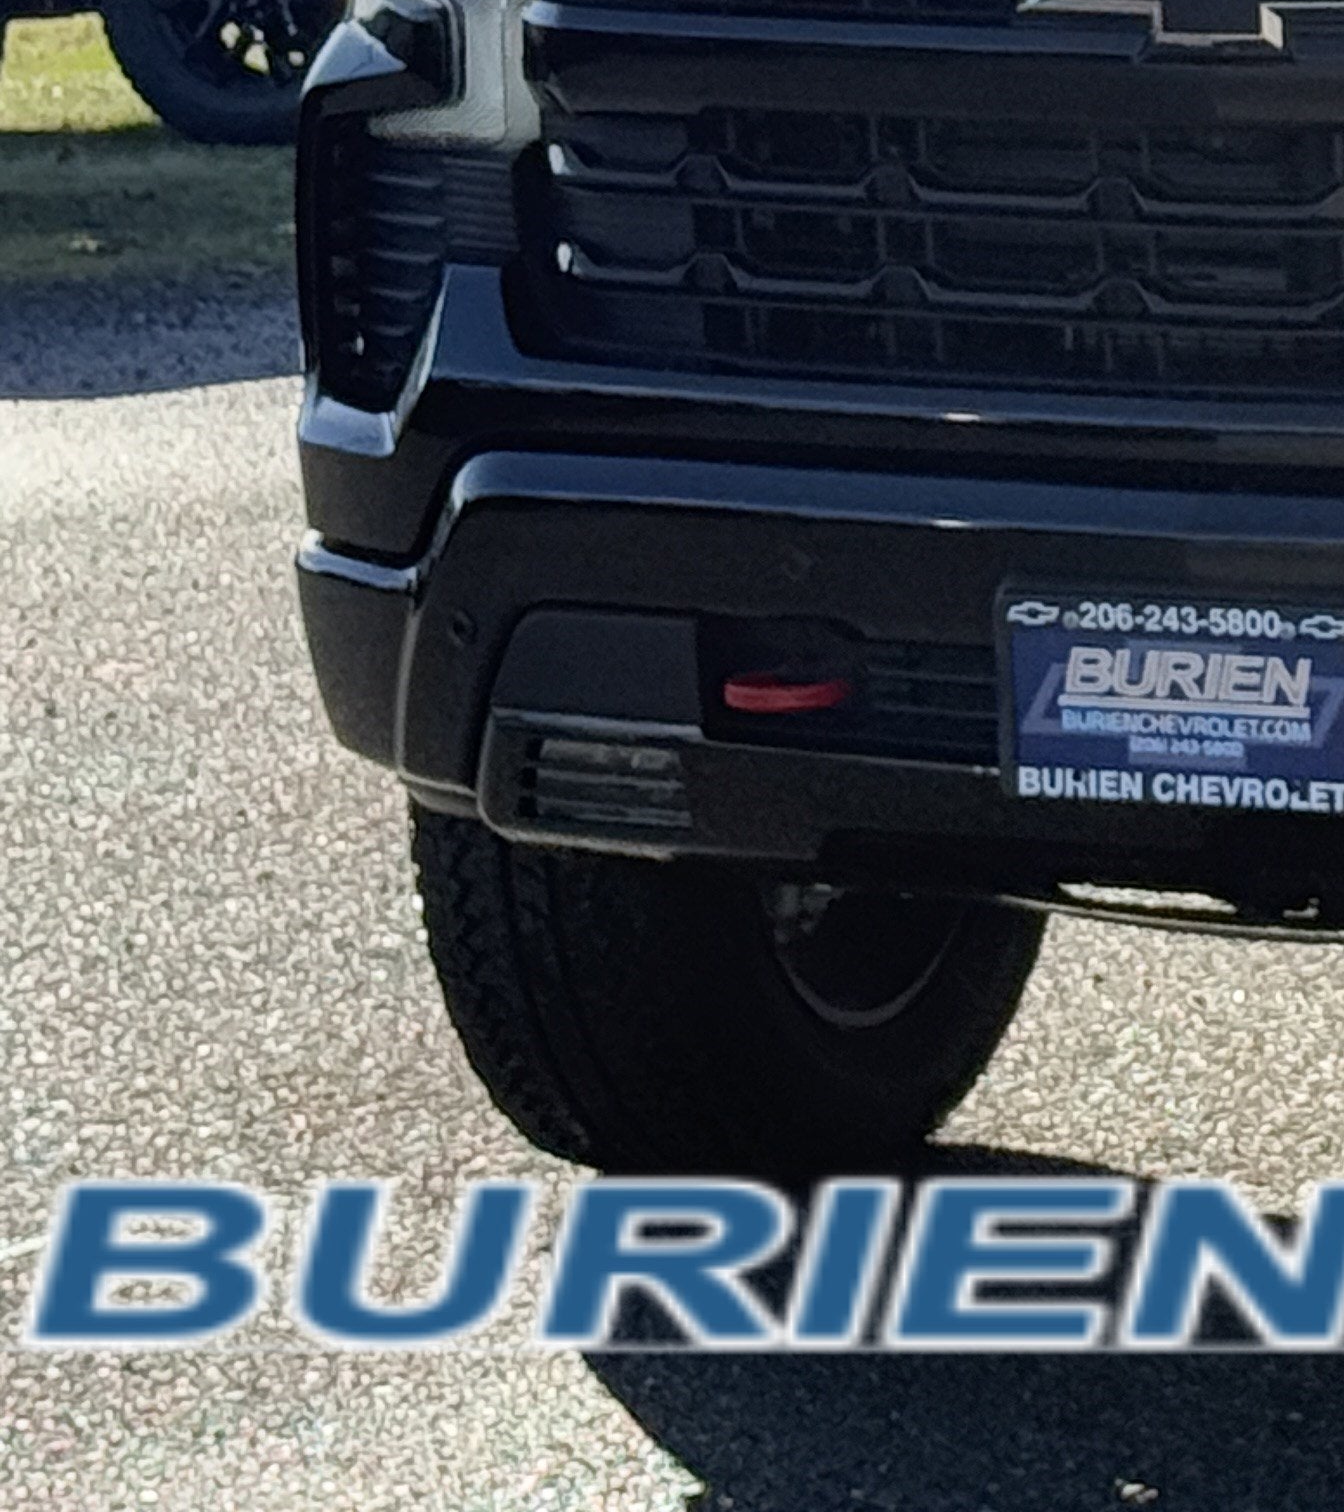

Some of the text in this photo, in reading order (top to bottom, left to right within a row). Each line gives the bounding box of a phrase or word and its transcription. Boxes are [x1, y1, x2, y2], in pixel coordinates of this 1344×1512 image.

[1078, 601, 1281, 639] 206-243-5800
[1064, 645, 1313, 707] BURIEN
[1017, 765, 1144, 802] BURIEN
